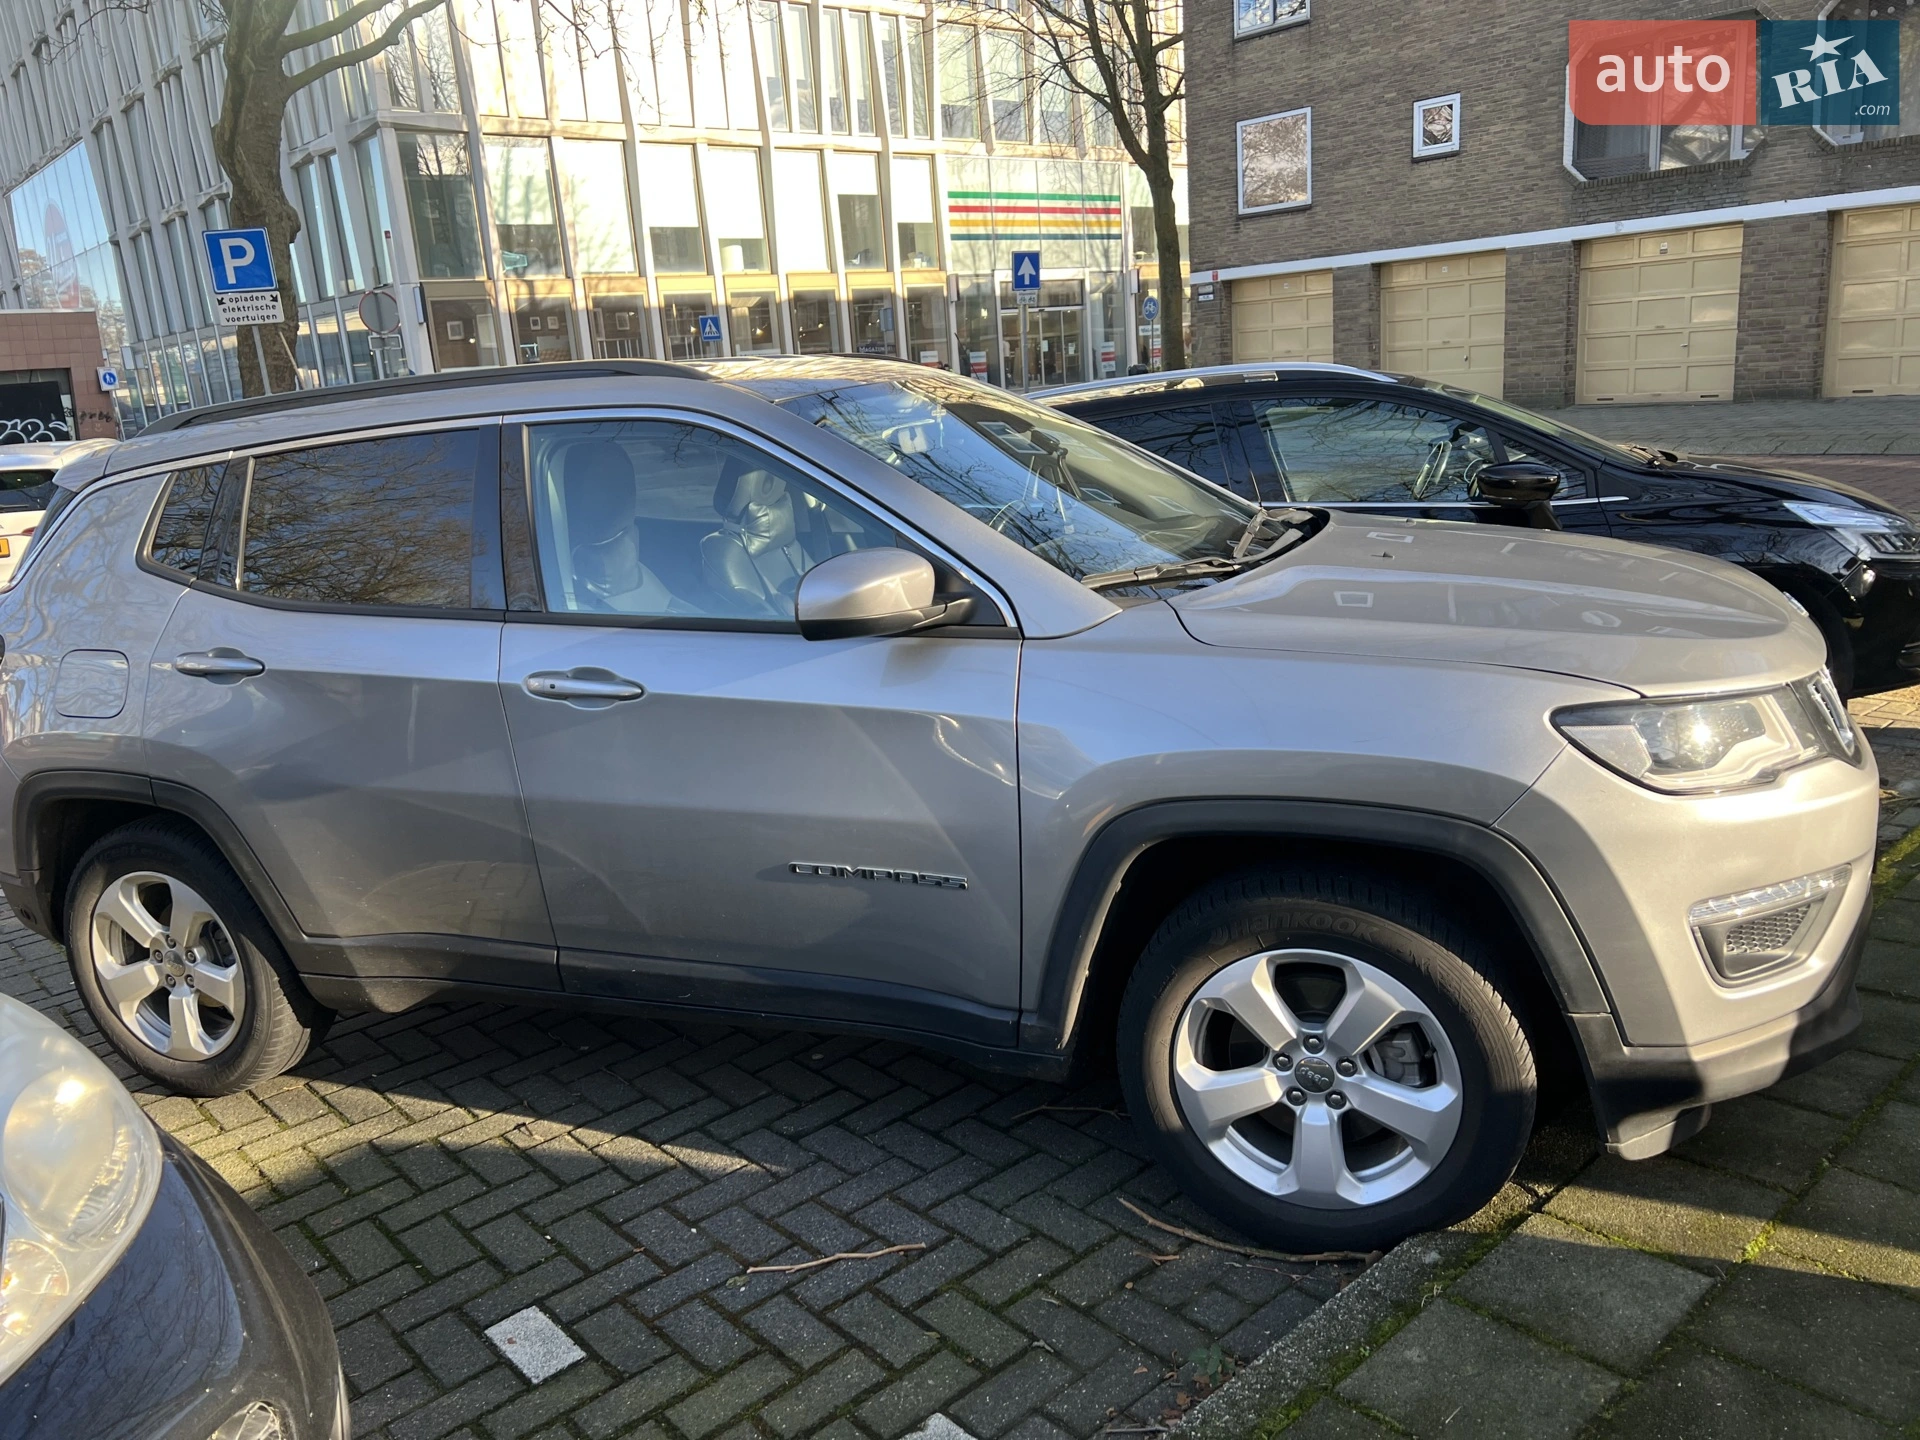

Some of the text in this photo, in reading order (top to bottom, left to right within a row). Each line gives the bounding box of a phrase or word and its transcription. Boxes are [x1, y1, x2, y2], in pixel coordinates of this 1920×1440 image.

[219, 237, 255, 284] P
[228, 294, 266, 304] opladen
[222, 303, 277, 313] elektrische
[225, 313, 277, 323] voertuigen
[787, 861, 969, 890] COMPASS
